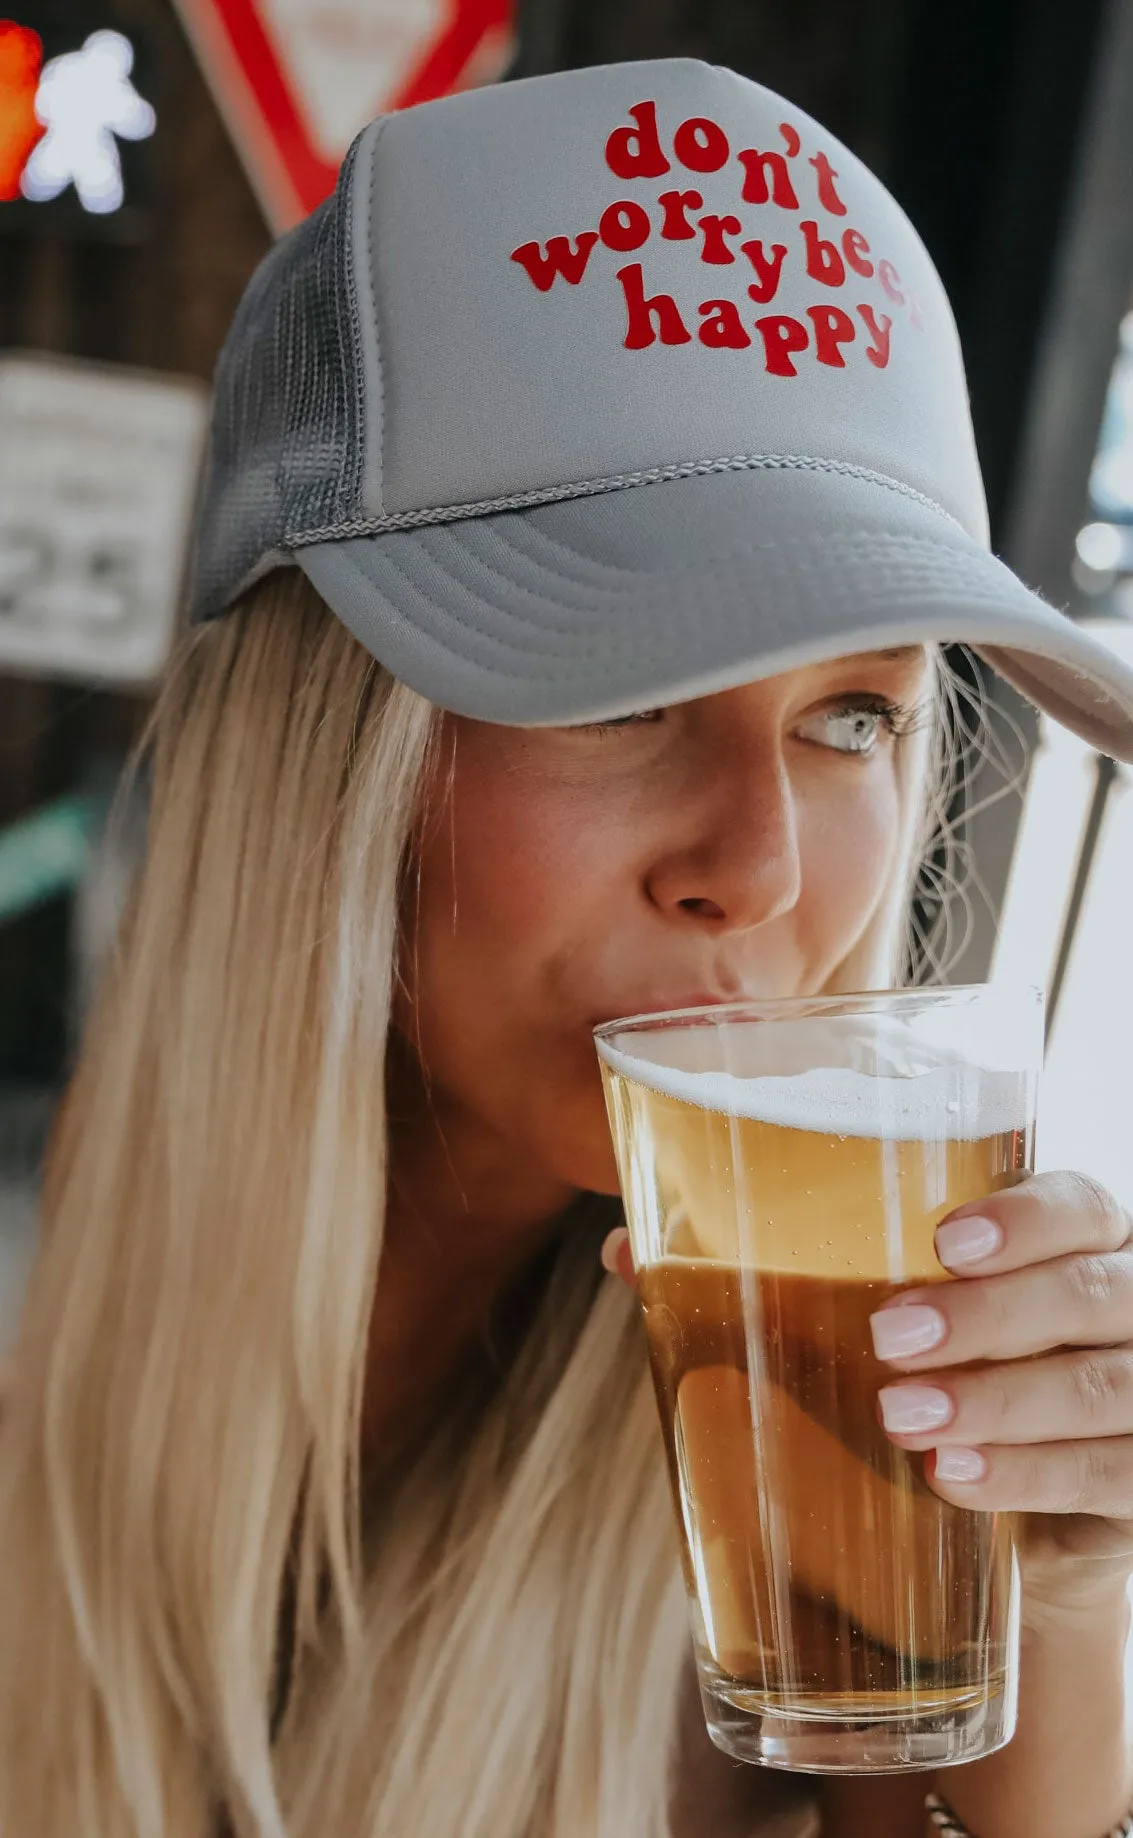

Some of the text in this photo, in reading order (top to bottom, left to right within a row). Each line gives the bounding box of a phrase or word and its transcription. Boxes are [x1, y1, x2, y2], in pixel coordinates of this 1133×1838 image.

[604, 100, 846, 216] don't
[510, 189, 923, 332] worry bee
[616, 263, 892, 376] happy
